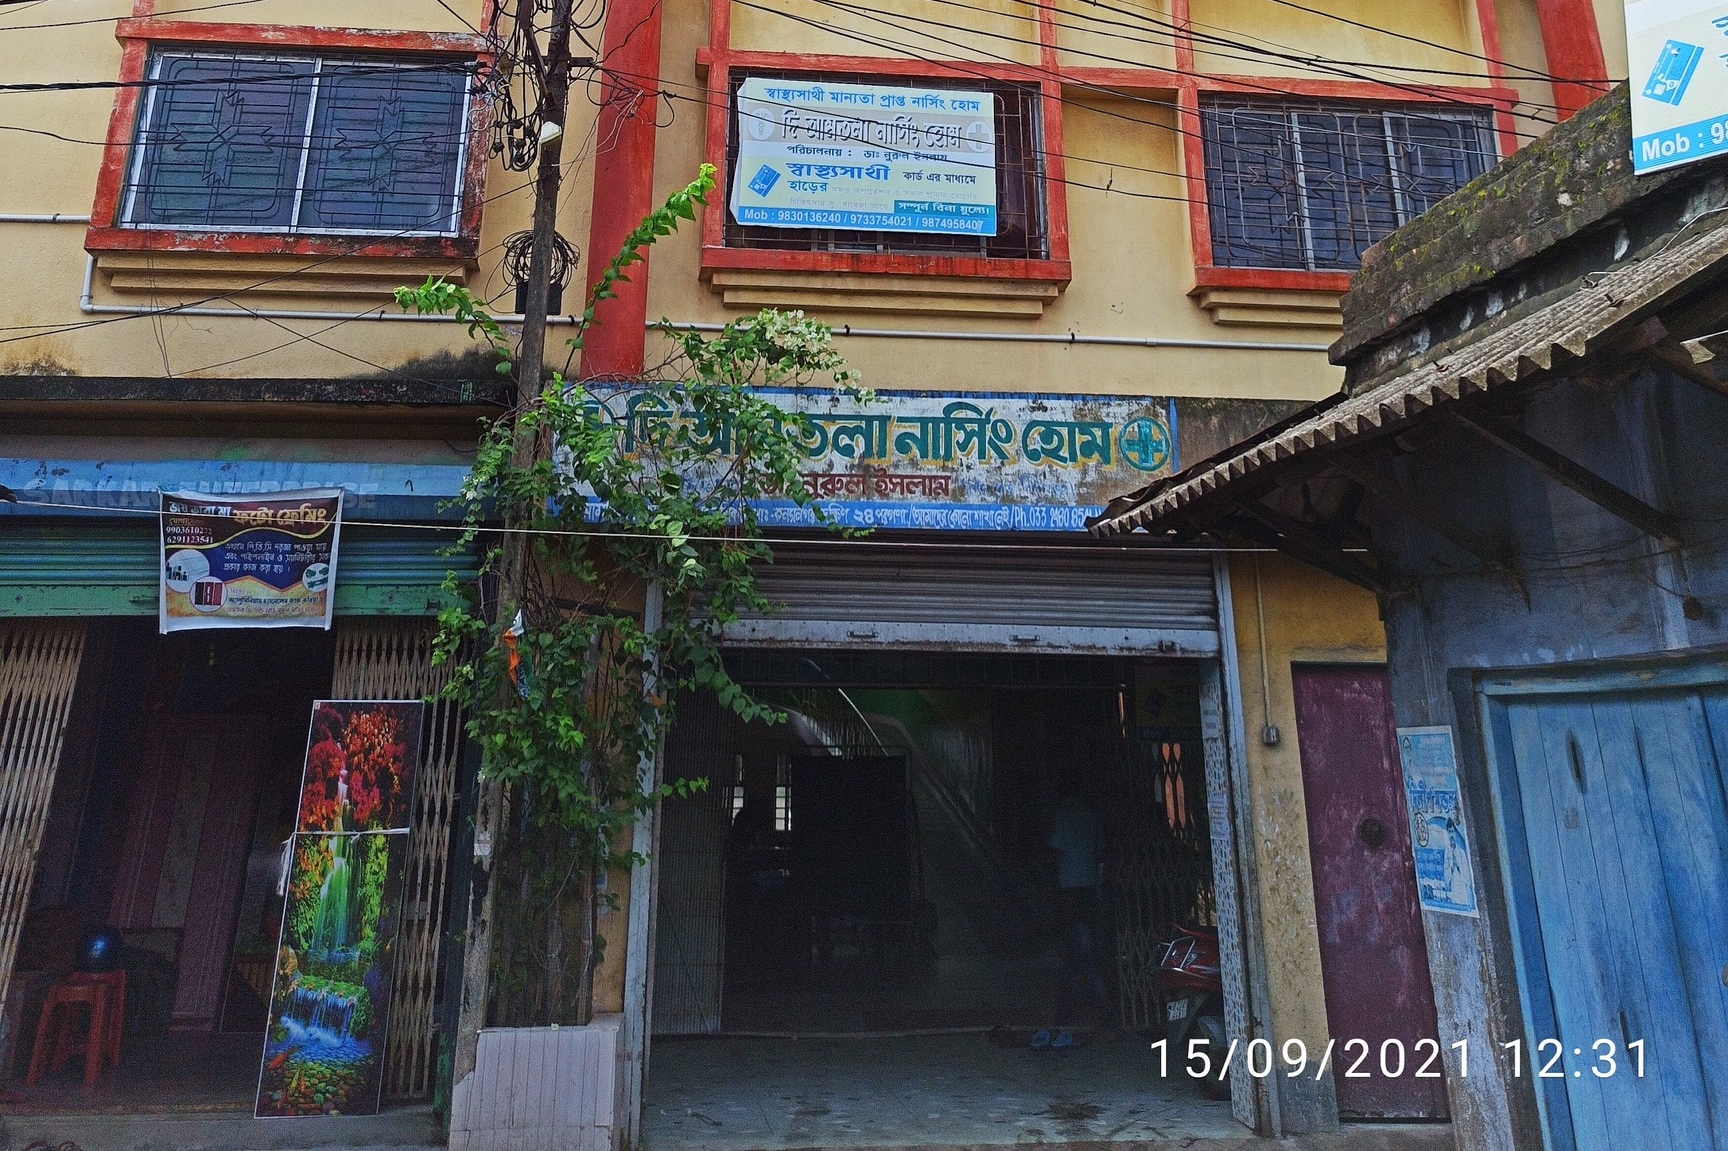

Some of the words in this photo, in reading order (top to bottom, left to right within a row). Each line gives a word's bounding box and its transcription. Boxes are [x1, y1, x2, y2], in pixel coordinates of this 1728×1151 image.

[764, 86, 825, 103] স্বাস্থ্যসাথী
[829, 90, 875, 106] মান্যতা
[879, 93, 906, 109] প্রাপ্ত
[910, 94, 946, 112] নার্সিং
[951, 98, 980, 113] হোম
[781, 108, 802, 140] দি
[875, 113, 920, 149] নার্সিং
[923, 123, 962, 150] হোম
[1641, 133, 1691, 162] Mob
[1697, 132, 1705, 148] :
[1710, 120, 1728, 145] 9
[786, 144, 843, 158] পরিচালনায়
[785, 162, 892, 182] স্বাস্থ্যসাথী
[902, 170, 923, 183] কার্ড
[926, 172, 941, 184] এর
[944, 174, 978, 186] মাধ্যমে
[788, 180, 828, 194] হাড়ের
[744, 209, 768, 220] Mob
[777, 211, 841, 224] 9830136240
[849, 213, 913, 226] 9733754021
[893, 401, 1015, 467] নার্সিং
[1021, 418, 1116, 467] হোম
[24, 478, 158, 509] SARKAR
[872, 467, 951, 497] ইসলাম
[853, 508, 875, 526] ২৪
[166, 535, 213, 544] 6291123541
